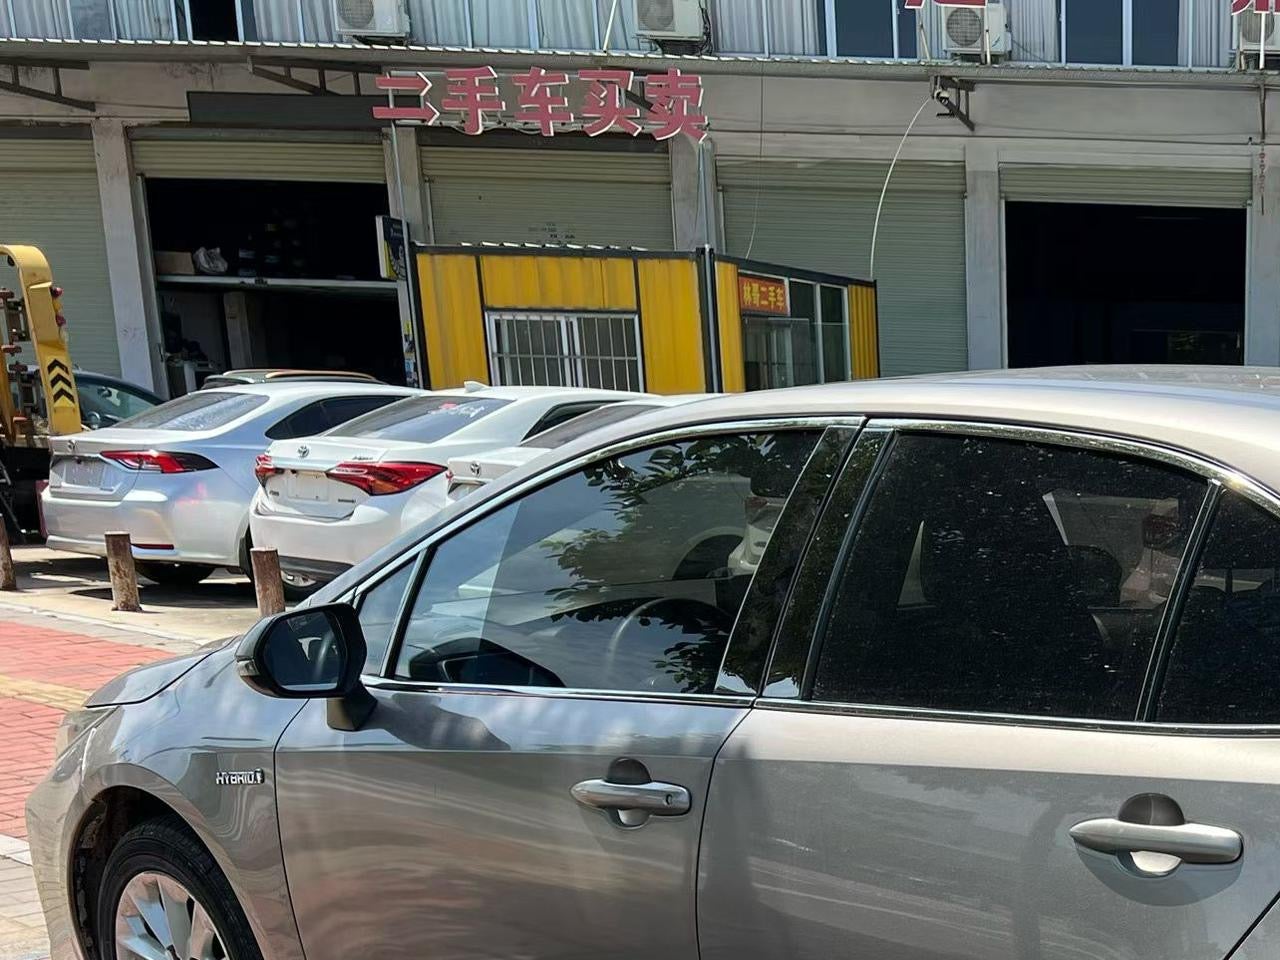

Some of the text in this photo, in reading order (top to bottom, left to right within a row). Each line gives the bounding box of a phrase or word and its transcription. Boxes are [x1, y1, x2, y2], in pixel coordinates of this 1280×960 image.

[372, 66, 708, 143] 二手车买卖
